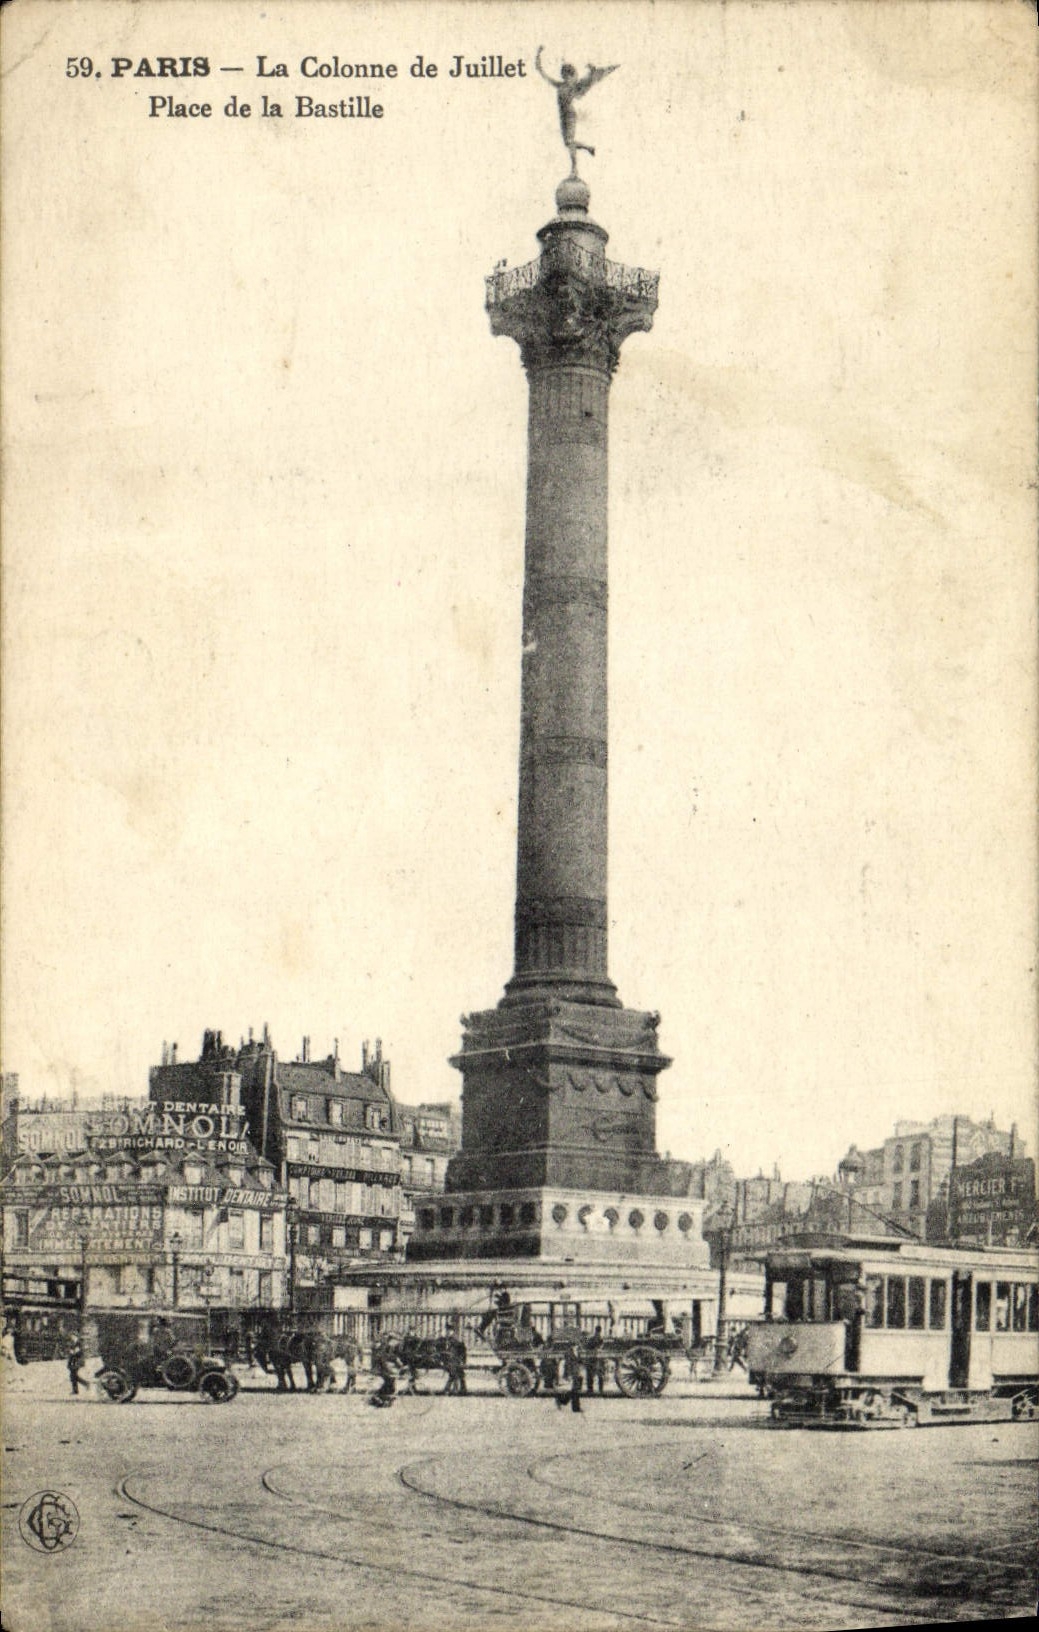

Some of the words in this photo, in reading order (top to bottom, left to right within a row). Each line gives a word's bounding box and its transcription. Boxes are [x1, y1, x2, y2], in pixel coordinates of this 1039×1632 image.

[163, 1101, 246, 1116] DENTAIRE
[60, 1186, 121, 1203] SOMNOL
[168, 1186, 220, 1202] INSTITUT
[223, 1189, 272, 1207] DENTAIRE
[956, 1179, 1006, 1197] MERCIER
